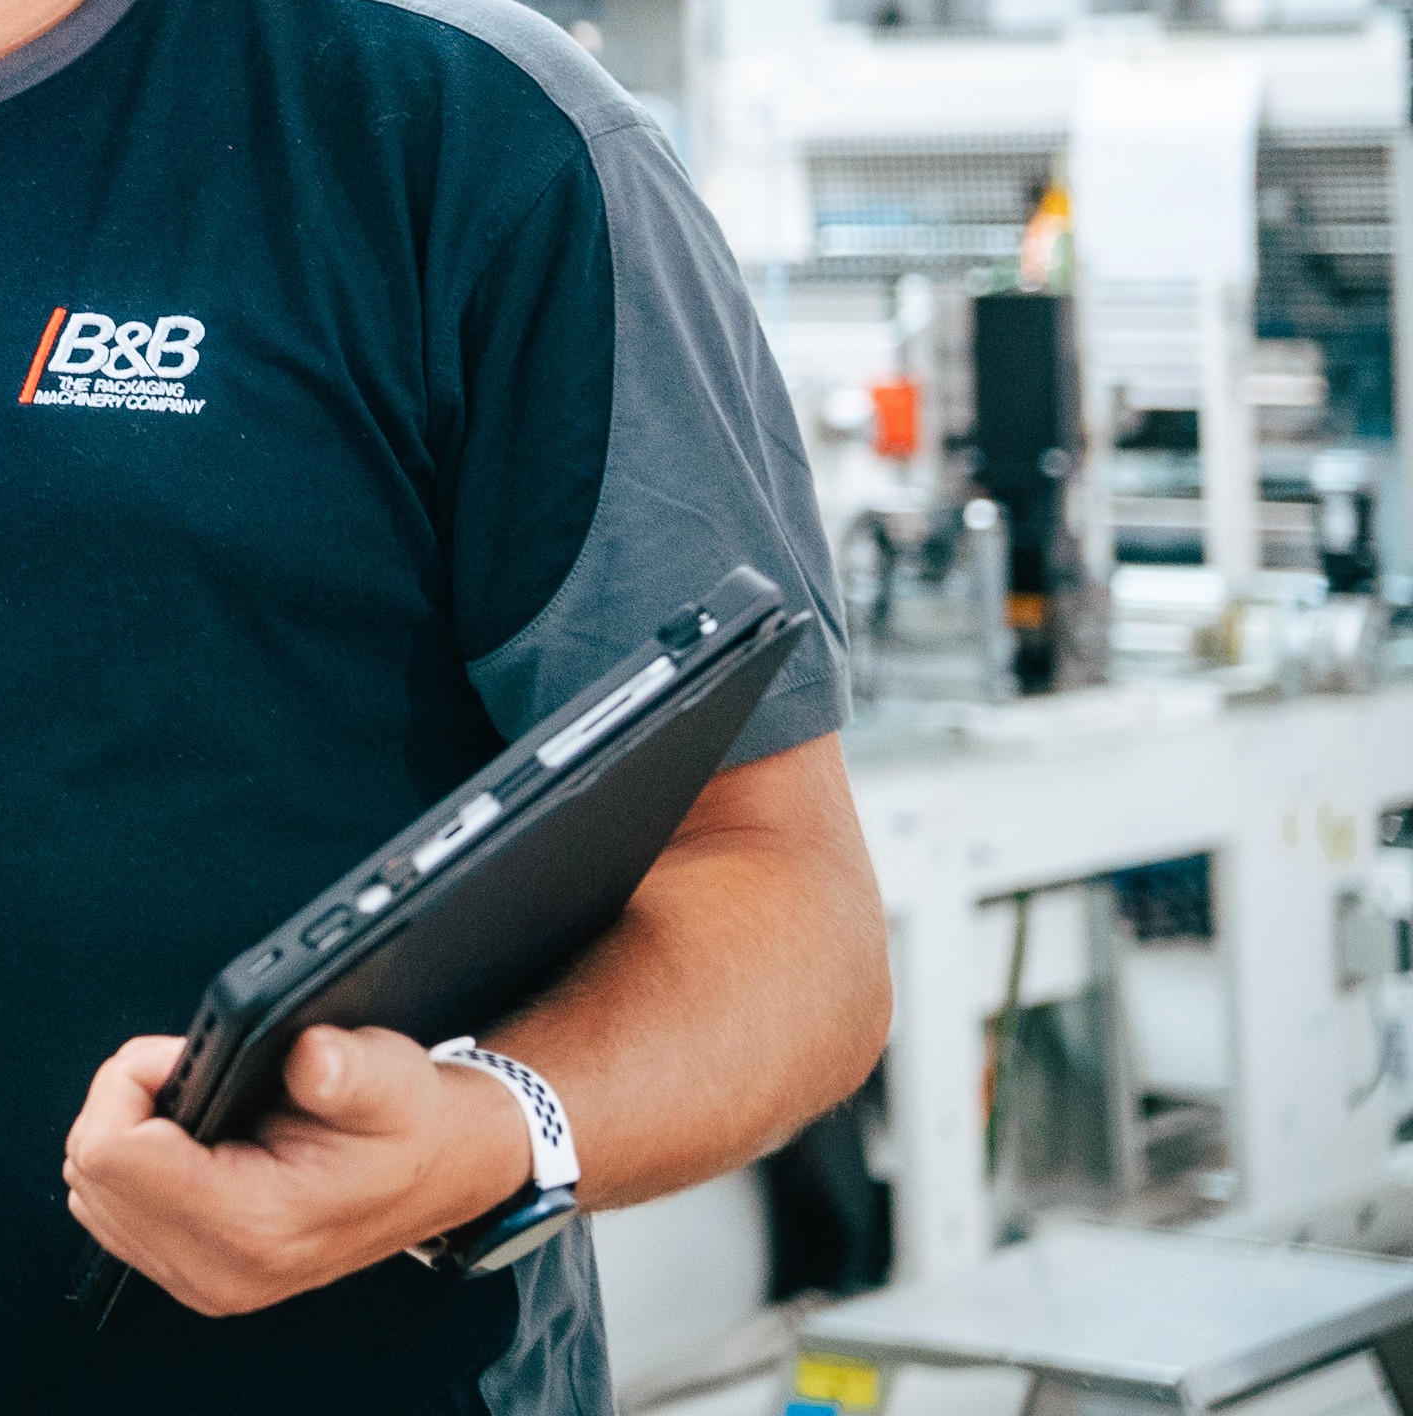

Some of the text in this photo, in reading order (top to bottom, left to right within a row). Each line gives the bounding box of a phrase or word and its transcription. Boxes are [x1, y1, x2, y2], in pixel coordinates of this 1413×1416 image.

[47, 311, 206, 379] B&B
[58, 376, 185, 397] THE PACKAGING
[34, 390, 206, 414] MACHINERY COMPANY
